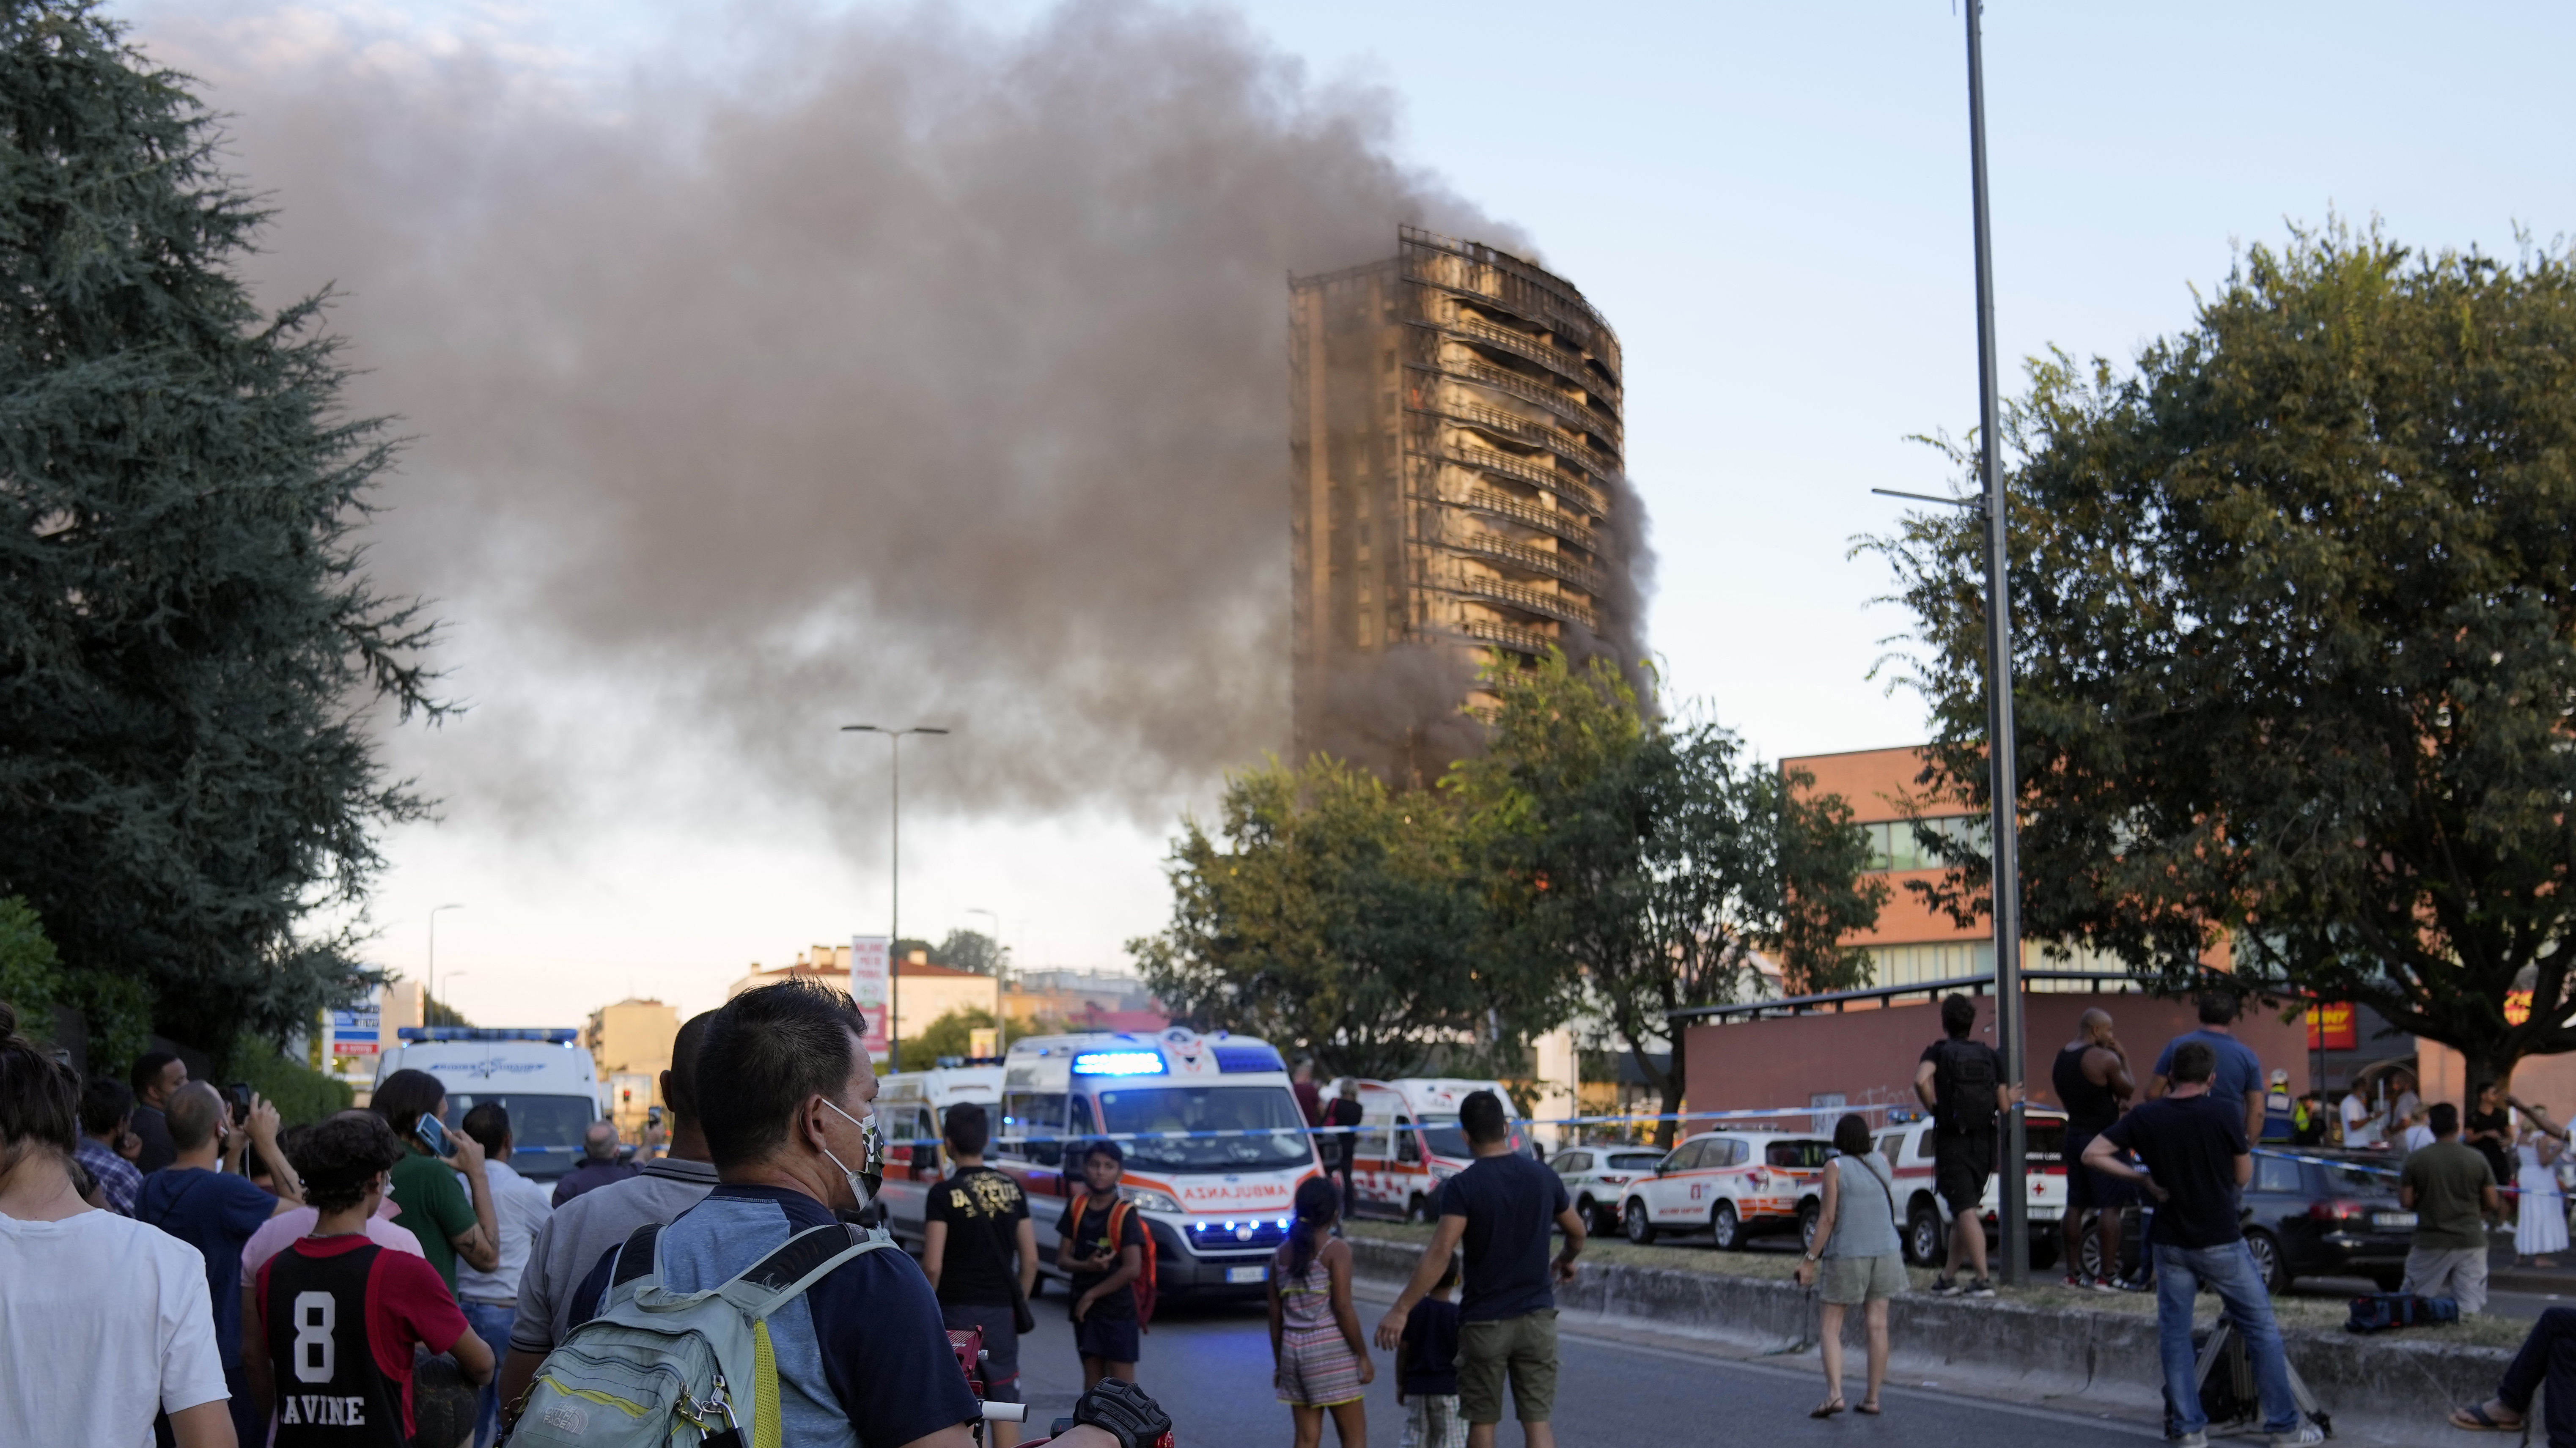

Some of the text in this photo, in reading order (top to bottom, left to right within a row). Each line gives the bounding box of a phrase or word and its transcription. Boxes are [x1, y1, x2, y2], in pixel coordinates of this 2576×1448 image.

[2306, 1009, 2350, 1025] ENNY
[294, 1291, 335, 1383] 8
[280, 1395, 365, 1426] AVINE
[557, 1402, 578, 1411] THE
[543, 1414, 568, 1429] FACE
